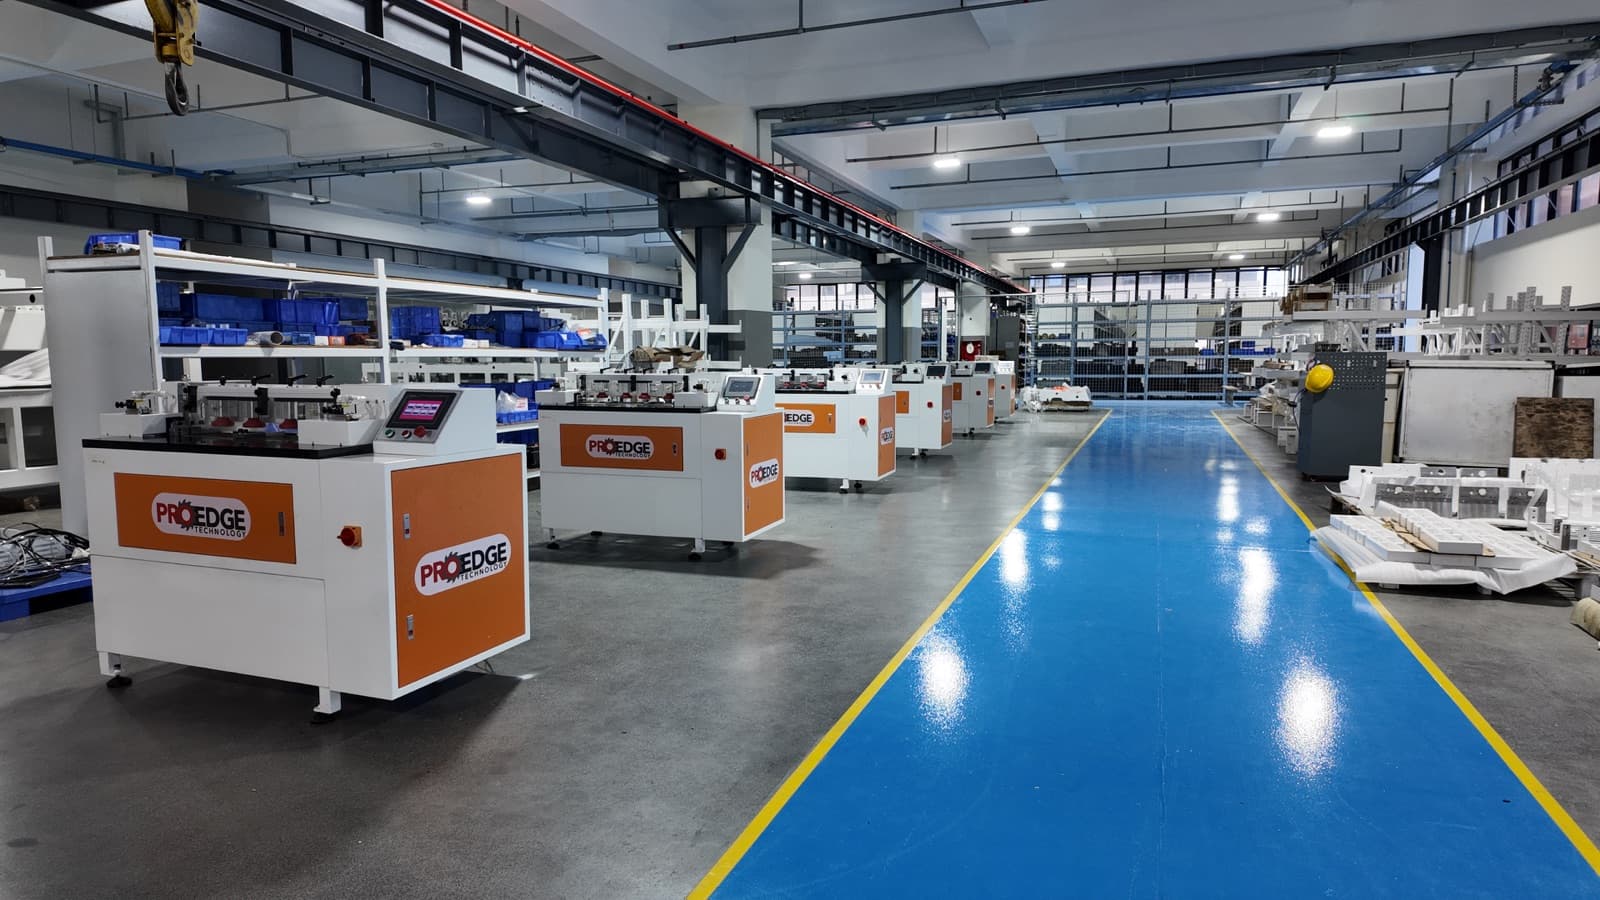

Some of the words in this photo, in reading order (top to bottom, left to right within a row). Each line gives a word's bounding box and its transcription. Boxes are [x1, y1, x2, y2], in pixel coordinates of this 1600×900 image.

[784, 413, 812, 423] EDGE
[589, 439, 650, 454] PROEDGE
[156, 501, 246, 531] PROEDGE
[195, 526, 246, 538] TECHNOLOGY
[420, 542, 507, 587] PROEDGE
[460, 562, 507, 581] TECHNOLOGY
